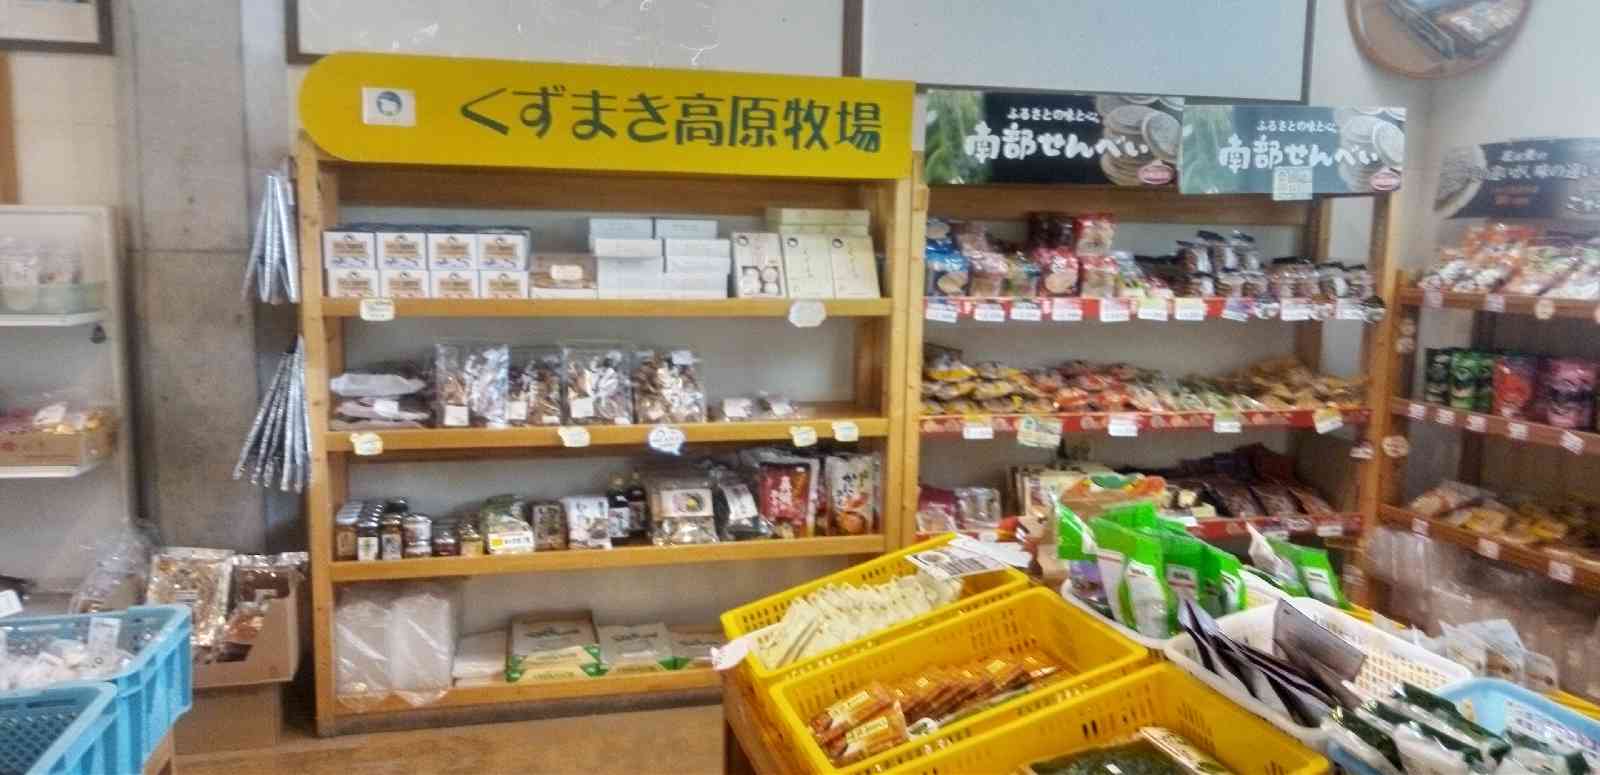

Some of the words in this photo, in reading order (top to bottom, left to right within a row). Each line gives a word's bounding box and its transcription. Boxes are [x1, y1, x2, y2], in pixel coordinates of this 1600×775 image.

[460, 86, 882, 153] くずまき高原牧場
[964, 121, 1149, 164] 南部せんべい
[1218, 133, 1378, 174] 南部せんべい
